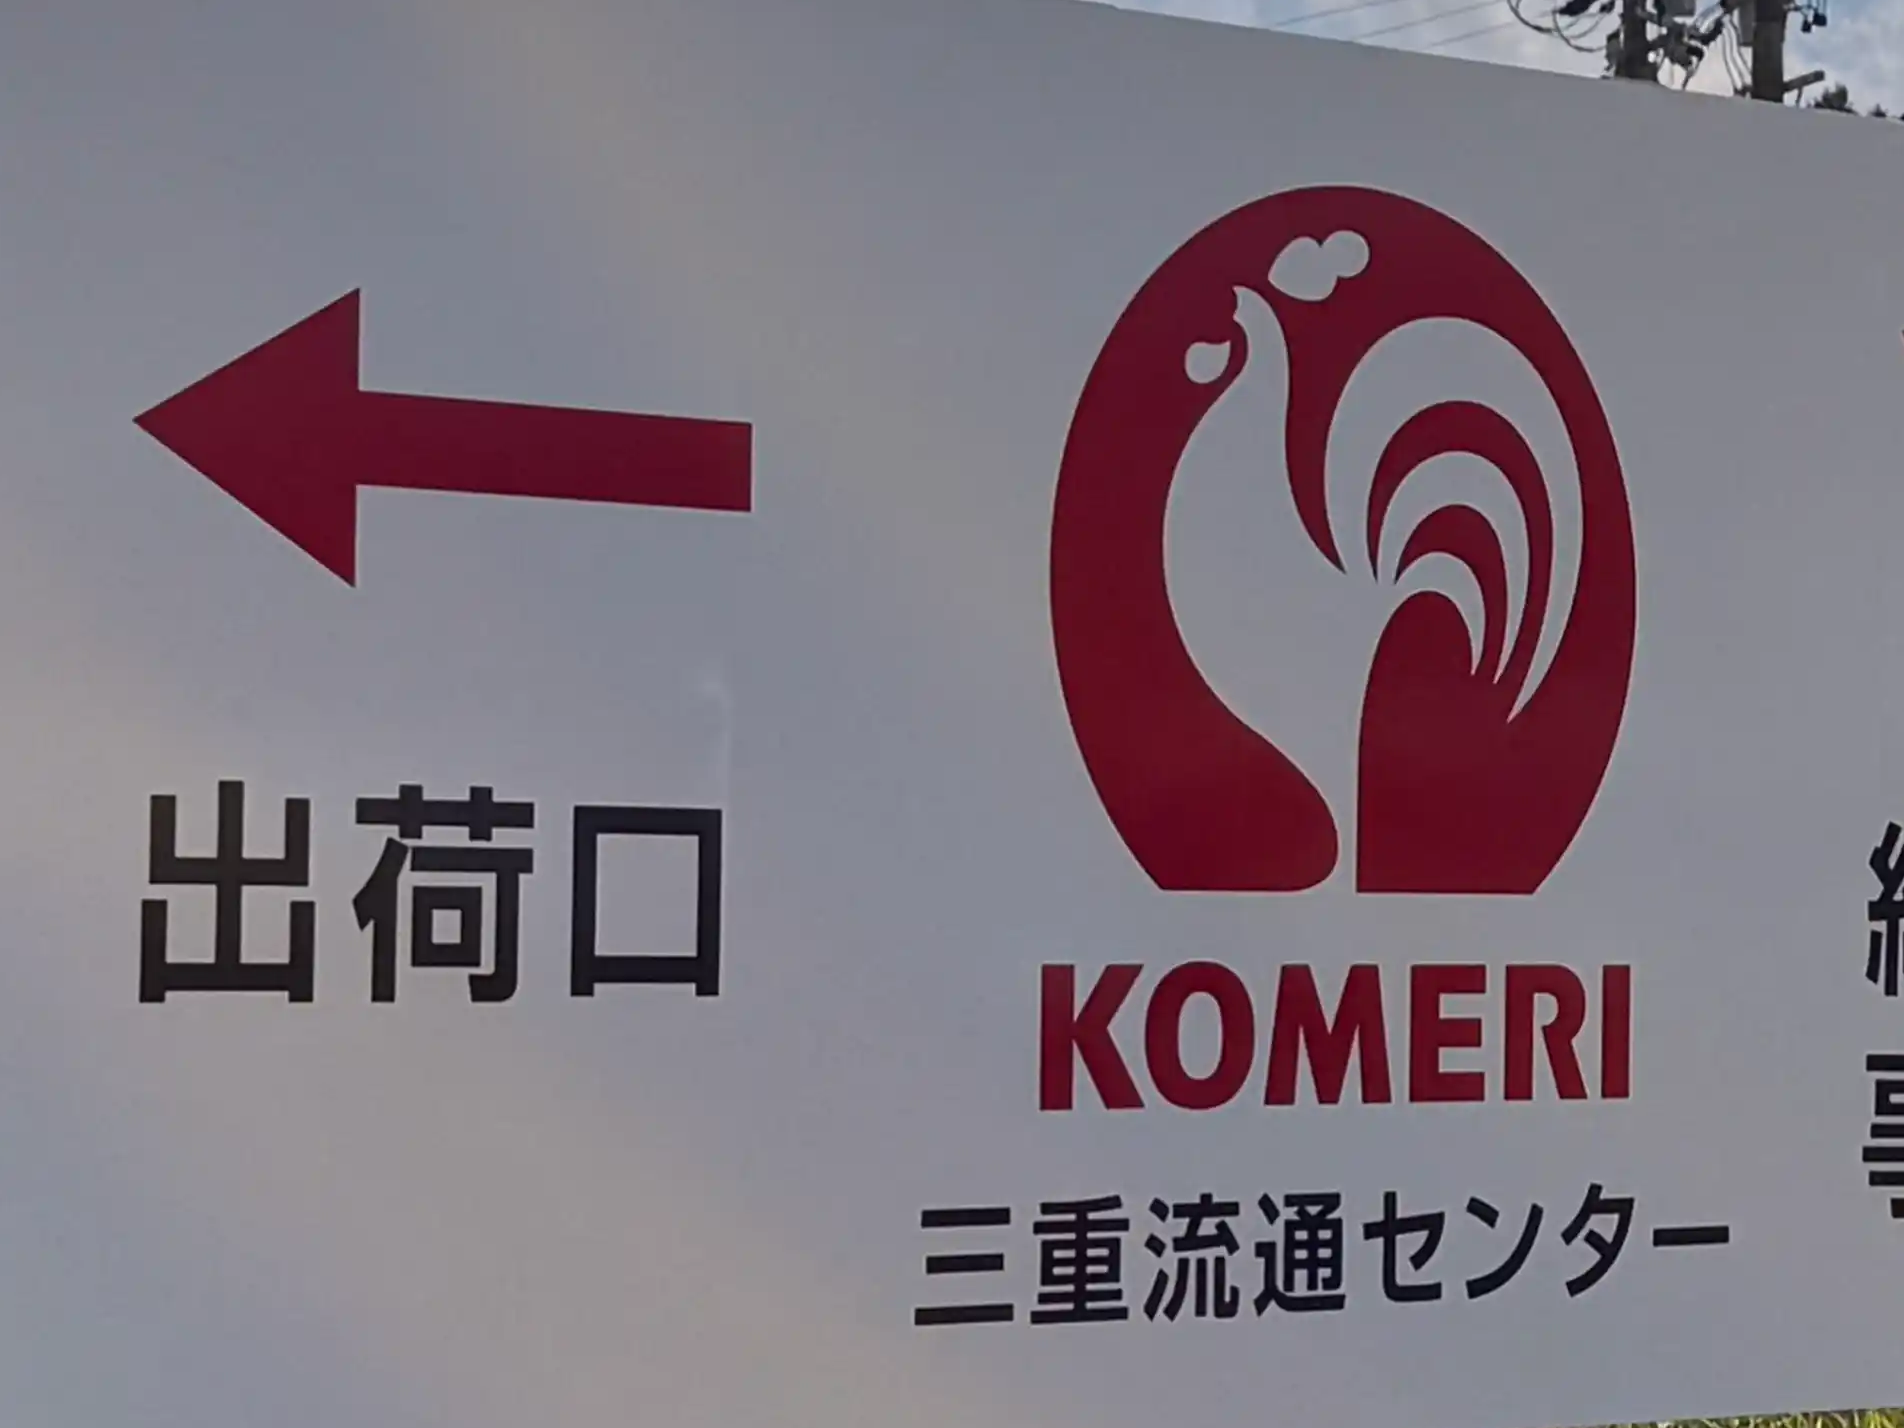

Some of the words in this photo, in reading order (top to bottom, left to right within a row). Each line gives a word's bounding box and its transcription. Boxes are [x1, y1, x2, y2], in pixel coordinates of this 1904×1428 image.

[137, 779, 724, 1005] 出荷口
[1040, 963, 1632, 1113] KOMERI
[913, 1181, 1732, 1328] 三重流通センター
